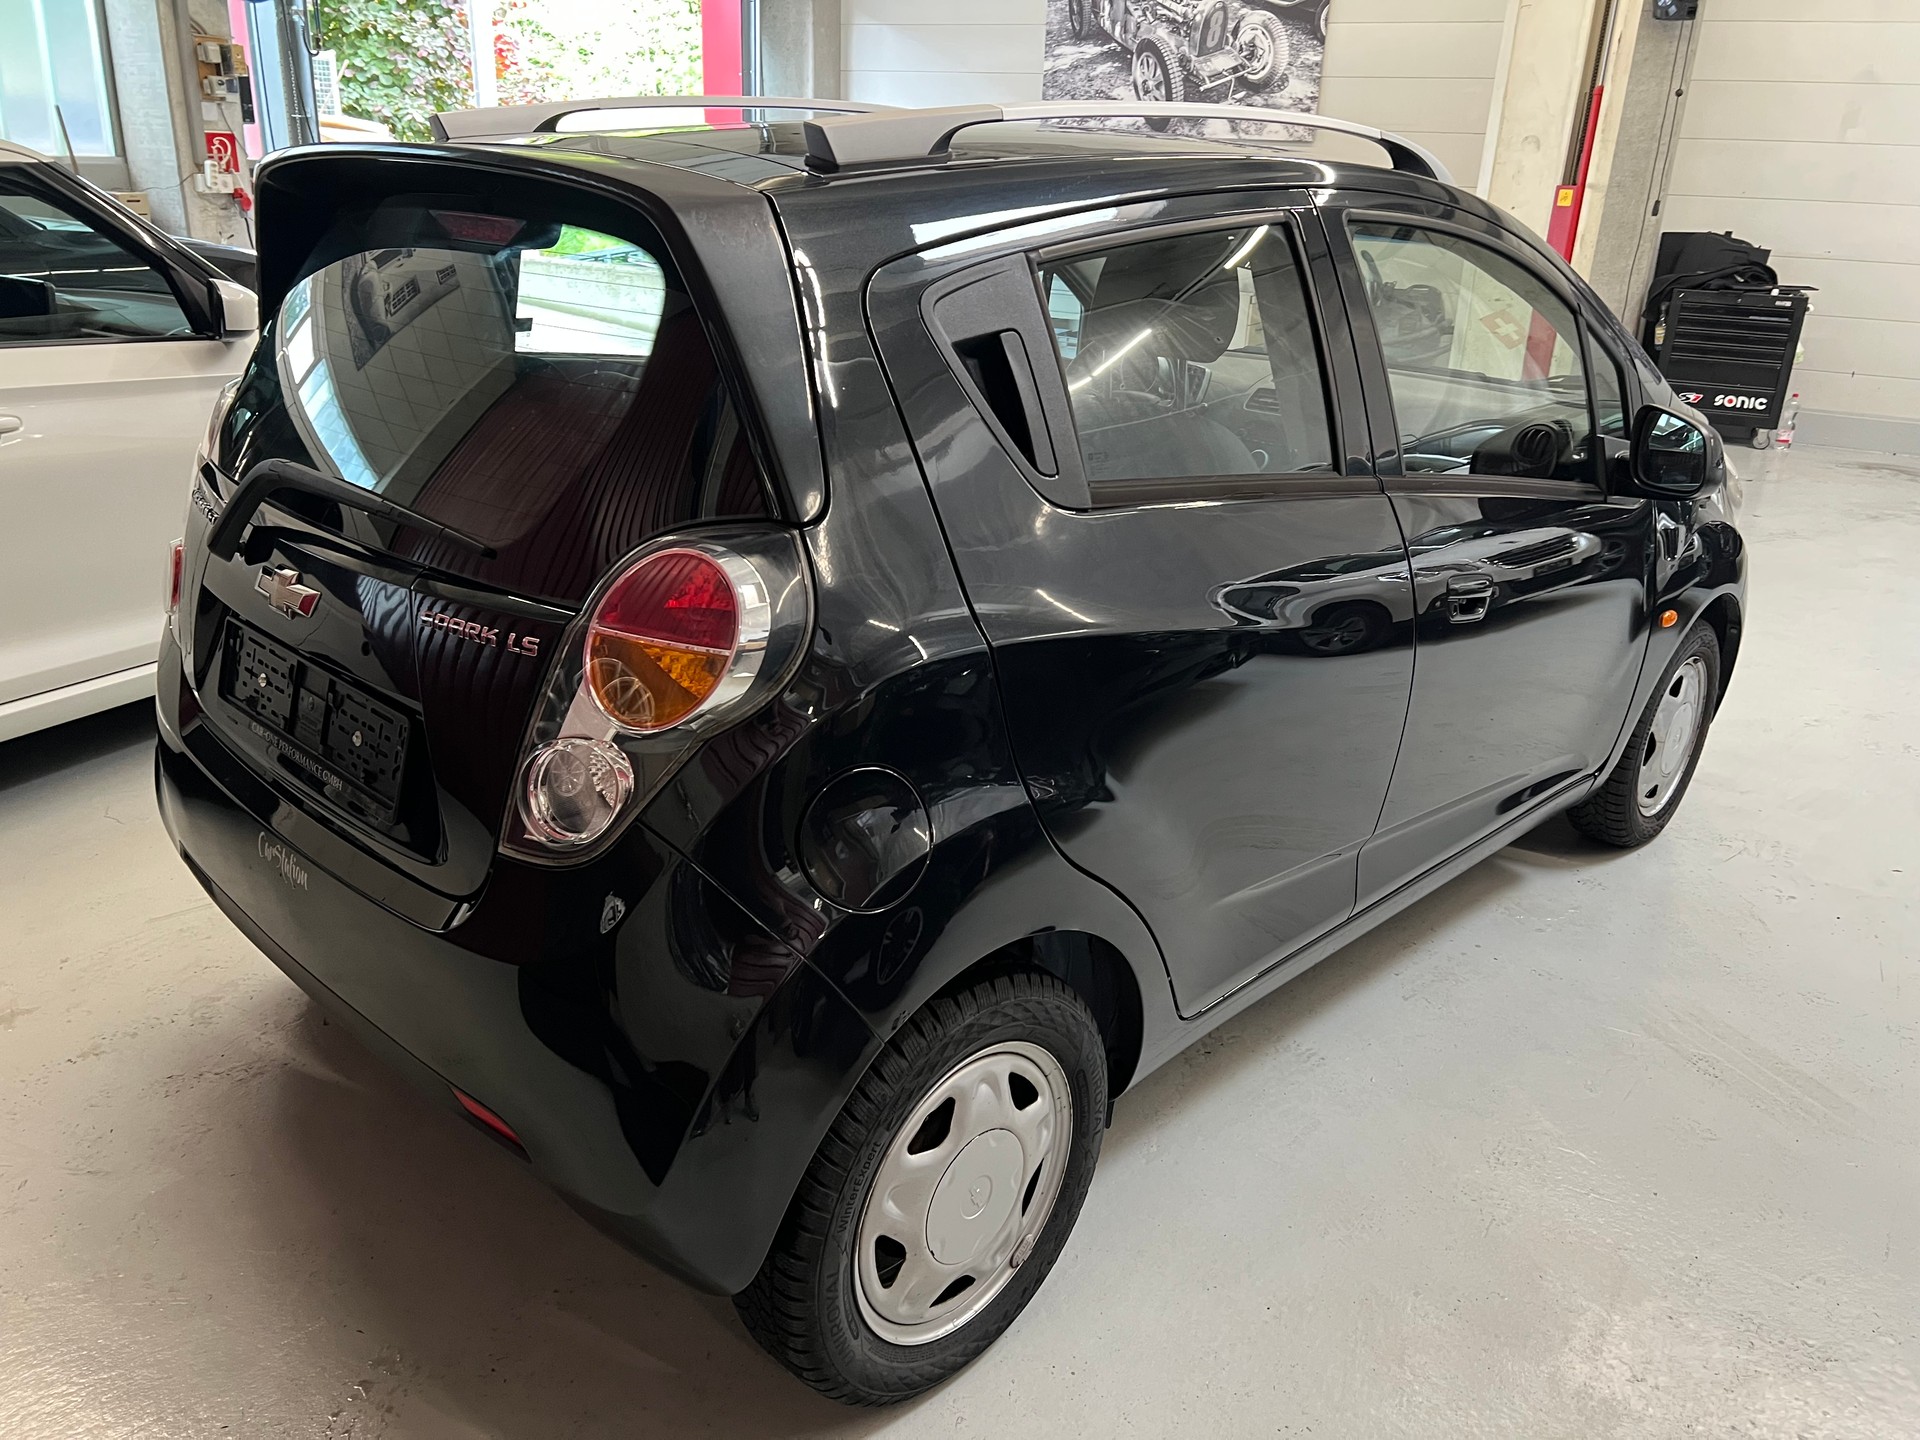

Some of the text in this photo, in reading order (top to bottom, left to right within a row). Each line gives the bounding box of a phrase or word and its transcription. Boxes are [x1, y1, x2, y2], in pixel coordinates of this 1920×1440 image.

[1206, 10, 1224, 48] 8
[420, 610, 540, 657] SPARK LS
[837, 1141, 882, 1234] WinterExpert
